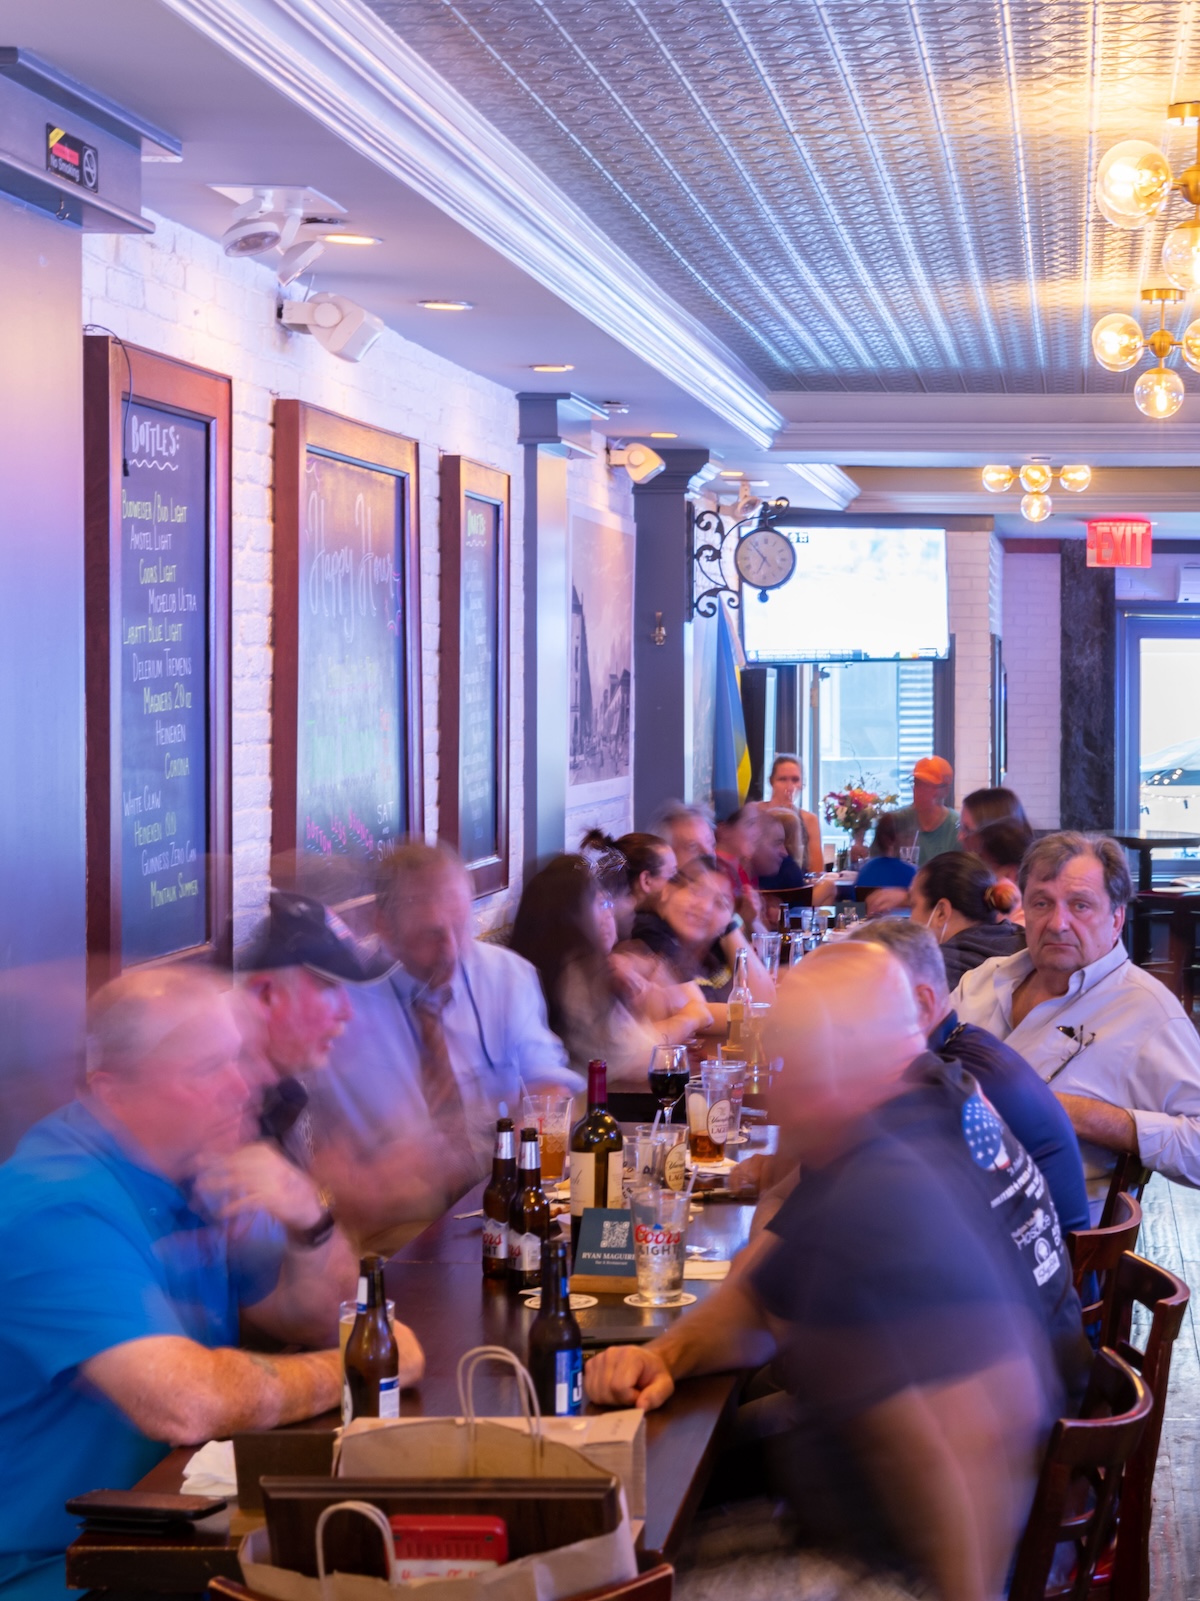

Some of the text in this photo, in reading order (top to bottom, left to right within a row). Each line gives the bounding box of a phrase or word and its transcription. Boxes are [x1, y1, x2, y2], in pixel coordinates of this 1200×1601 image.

[131, 415, 180, 457] BOTTLES:
[170, 497, 188, 522] LIGHT
[129, 522, 173, 550] AMSTEL LIGHT
[1096, 526, 1147, 566] EXIT
[140, 557, 177, 584] COORS LIGHT
[149, 587, 197, 613] MICHELOB ULTRA
[123, 617, 183, 644] LABATT BLUE LIGHT
[163, 648, 192, 676] TREMENS
[143, 687, 172, 714] MAGNERS
[156, 720, 186, 745] HEINEKEN
[165, 752, 190, 779] CORONA
[123, 785, 162, 816] WHITE CLAW
[377, 801, 394, 824] SAT
[134, 820, 162, 847] HEINEKEN
[169, 841, 184, 867] ZERO
[185, 840, 197, 862] CAN
[377, 837, 395, 862] SUN
[635, 1223, 681, 1244] Coors
[582, 1251, 601, 1260] RYAN
